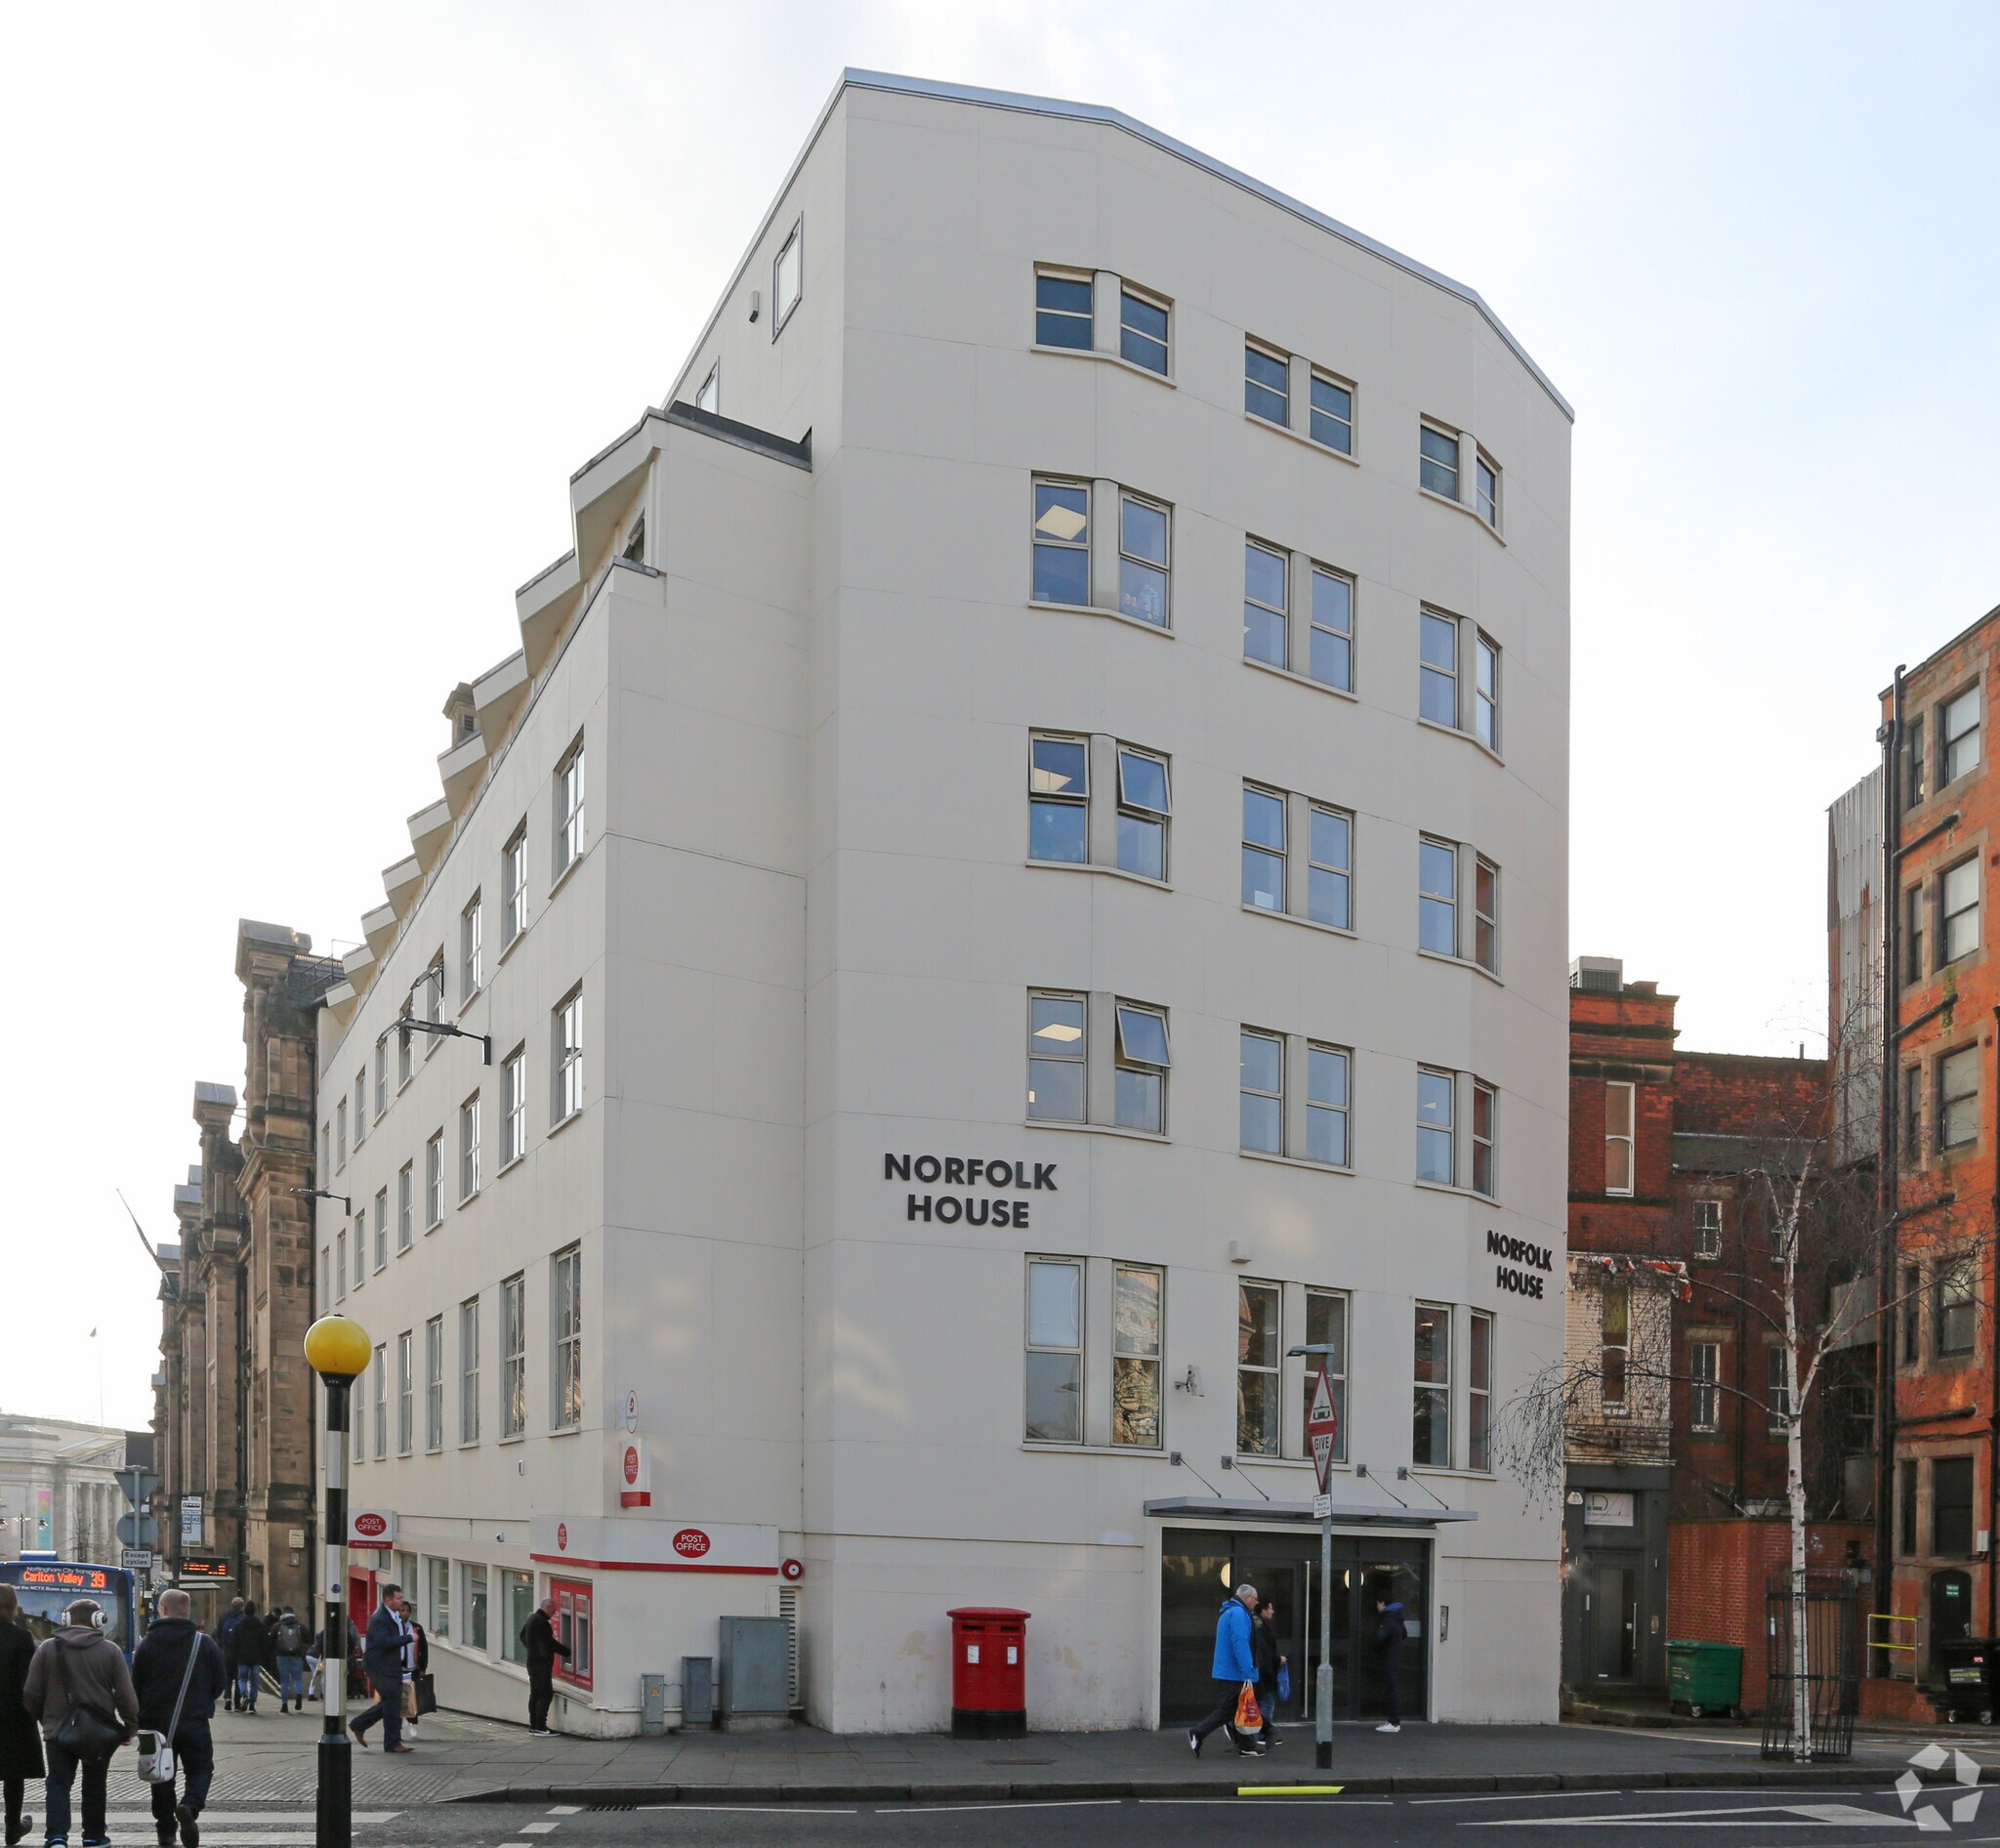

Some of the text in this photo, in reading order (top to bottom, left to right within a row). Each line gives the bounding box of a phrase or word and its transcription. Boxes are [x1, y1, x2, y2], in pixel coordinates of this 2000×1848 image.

[885, 1153, 1059, 1191] NORFOLK
[907, 1194, 1029, 1229] HOUSE
[1487, 1230, 1553, 1272] NORFOLK
[1496, 1265, 1544, 1299] HOUSE
[1313, 1437, 1329, 1450] GIVE
[1317, 1452, 1328, 1462] WAY
[676, 1542, 706, 1552] OFFICE
[681, 1534, 703, 1543] POST
[22, 1571, 106, 1588] Carlton Valley 39
